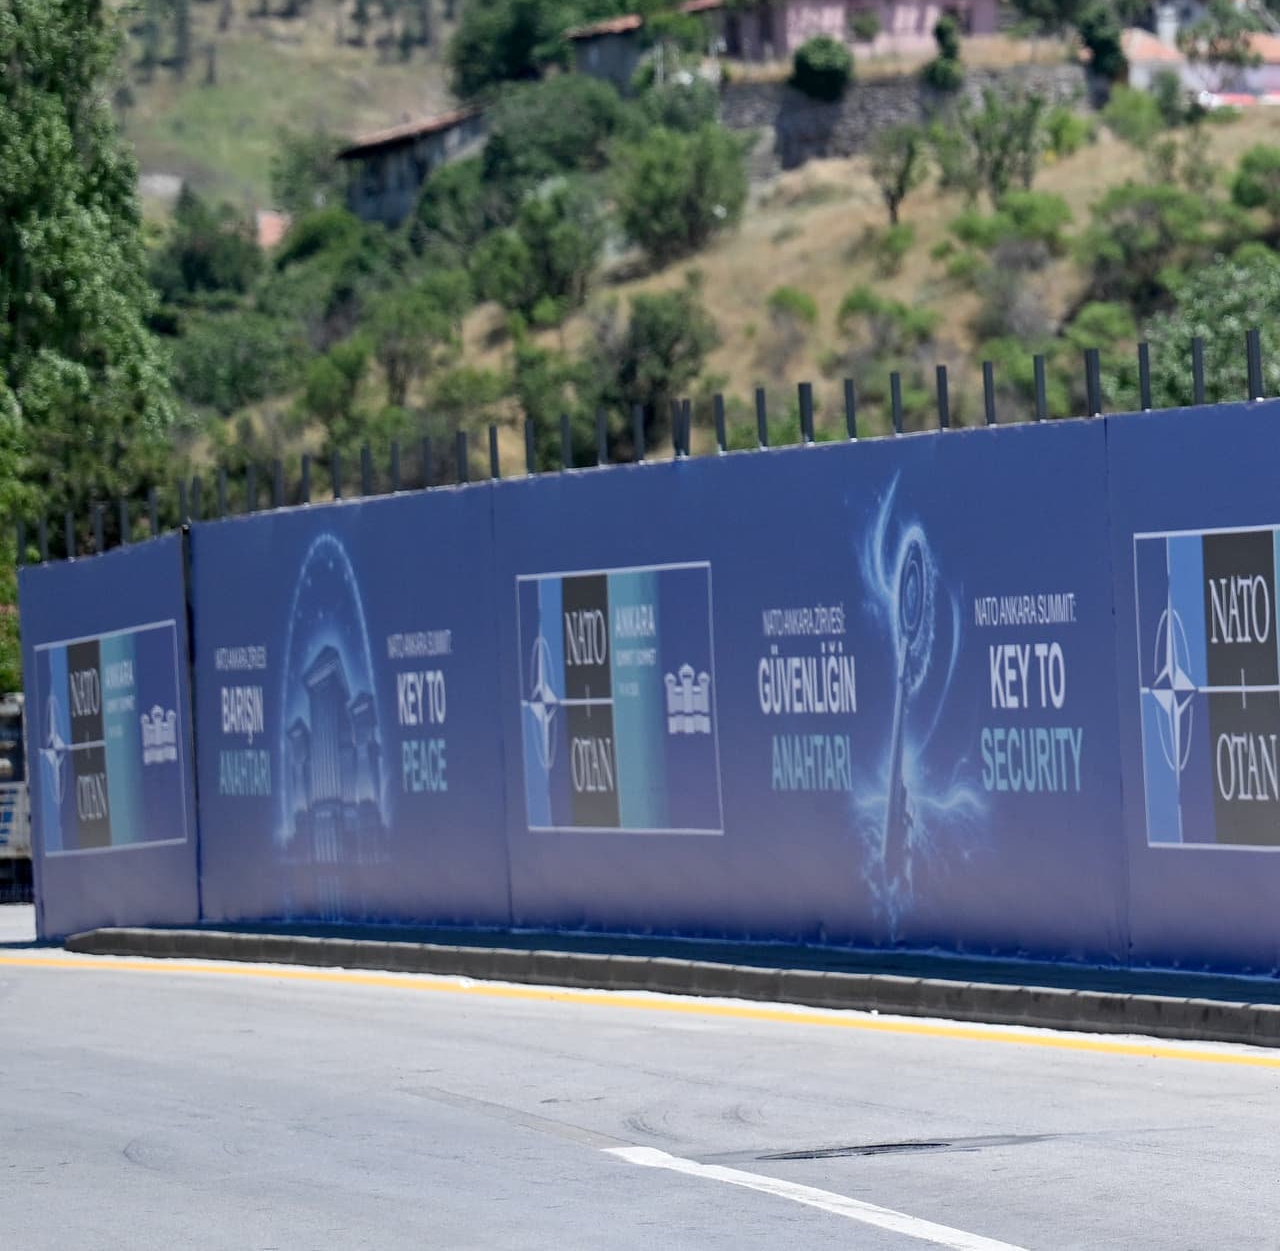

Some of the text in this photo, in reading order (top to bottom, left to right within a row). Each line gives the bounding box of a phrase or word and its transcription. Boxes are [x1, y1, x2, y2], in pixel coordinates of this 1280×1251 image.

[565, 609, 607, 666] NATO
[975, 597, 998, 626] NATO
[1000, 595, 1037, 625] ANKARA
[1209, 575, 1270, 643] NATO
[397, 669, 447, 725] KEY TO
[758, 641, 857, 715] GÜVENLİĞİN
[990, 642, 1065, 709] KEY TO
[402, 738, 448, 793] PEACE
[571, 737, 614, 792] OTAN
[771, 735, 852, 791] ANAHTARI
[981, 727, 1083, 792] SECURITY
[1217, 734, 1279, 802] OTAN
